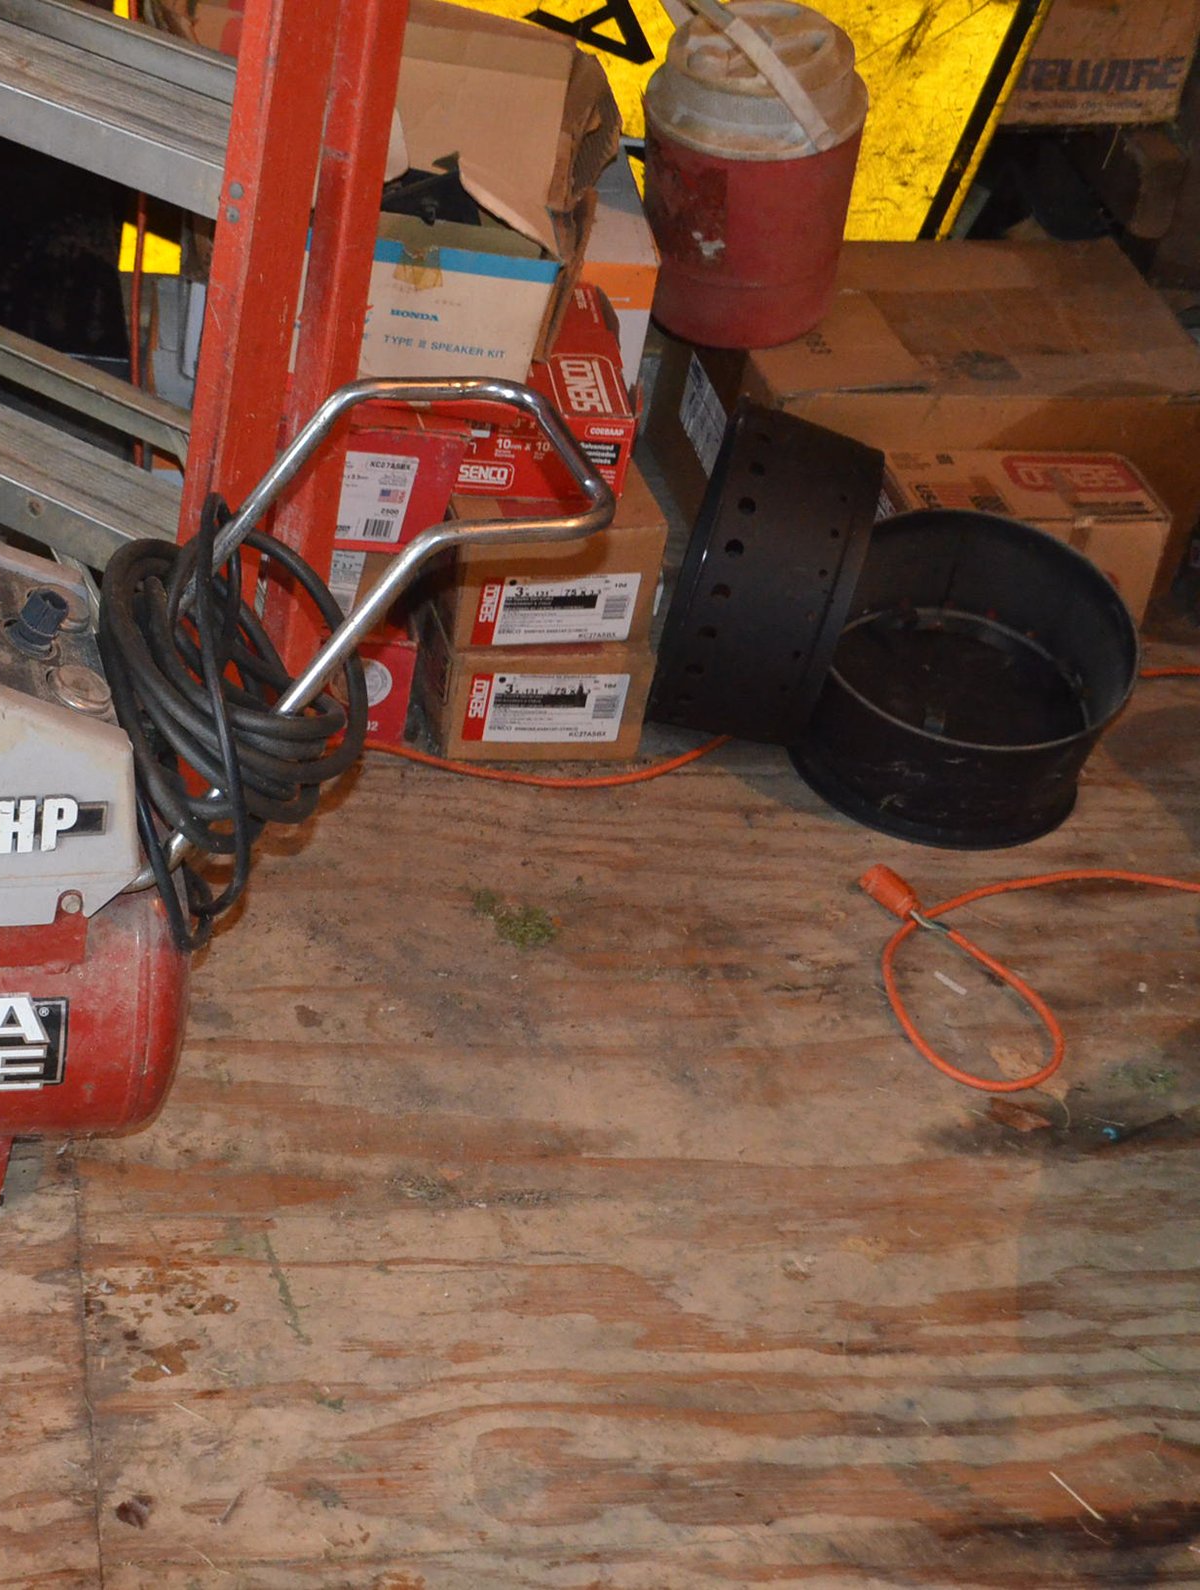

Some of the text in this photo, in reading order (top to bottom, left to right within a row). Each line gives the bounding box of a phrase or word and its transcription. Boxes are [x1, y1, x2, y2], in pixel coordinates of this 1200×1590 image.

[390, 309, 440, 322] HONDA
[384, 335, 413, 348] TYPE
[431, 341, 484, 357] SPEAKER
[487, 350, 506, 359] KIT
[560, 360, 606, 413] SENCO
[458, 464, 509, 484] SENCO
[479, 584, 501, 623] SENCO
[468, 679, 491, 718] SENCO
